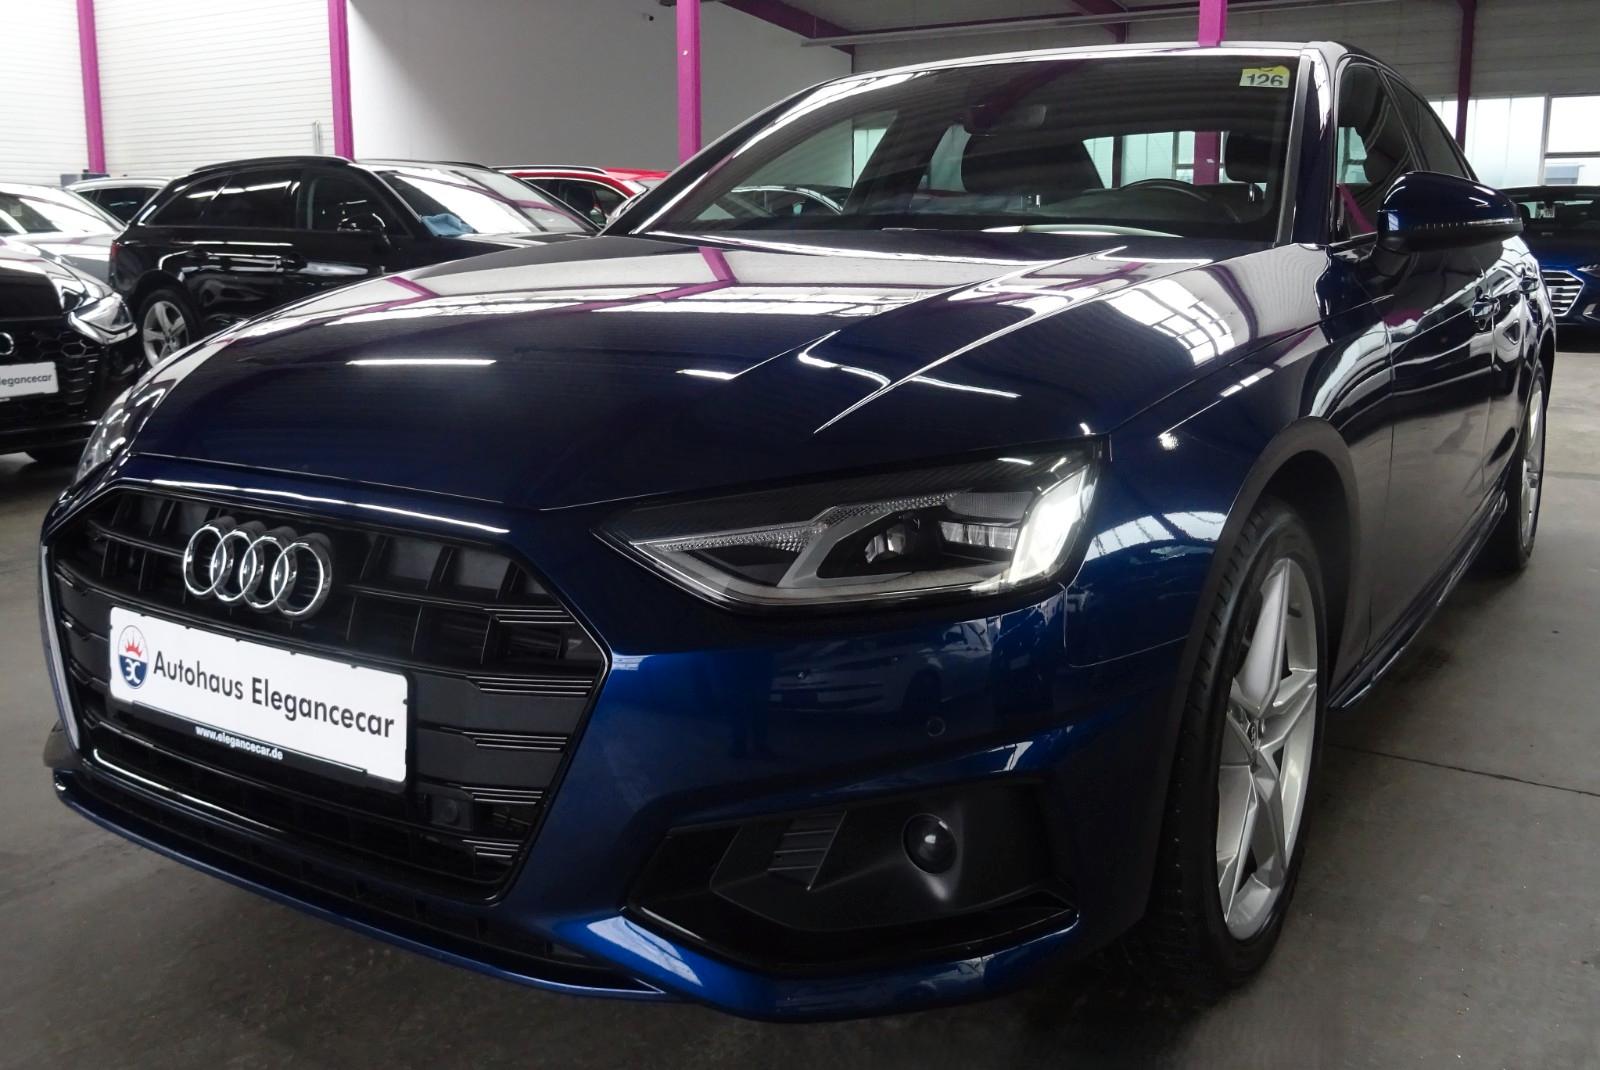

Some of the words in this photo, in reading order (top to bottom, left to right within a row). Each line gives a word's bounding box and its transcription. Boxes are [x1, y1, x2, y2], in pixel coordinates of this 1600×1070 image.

[1246, 73, 1284, 87] 126
[153, 650, 244, 700] Autohaus
[251, 677, 394, 738] Elegancecar
[195, 725, 283, 760] www.elegancecar.de
